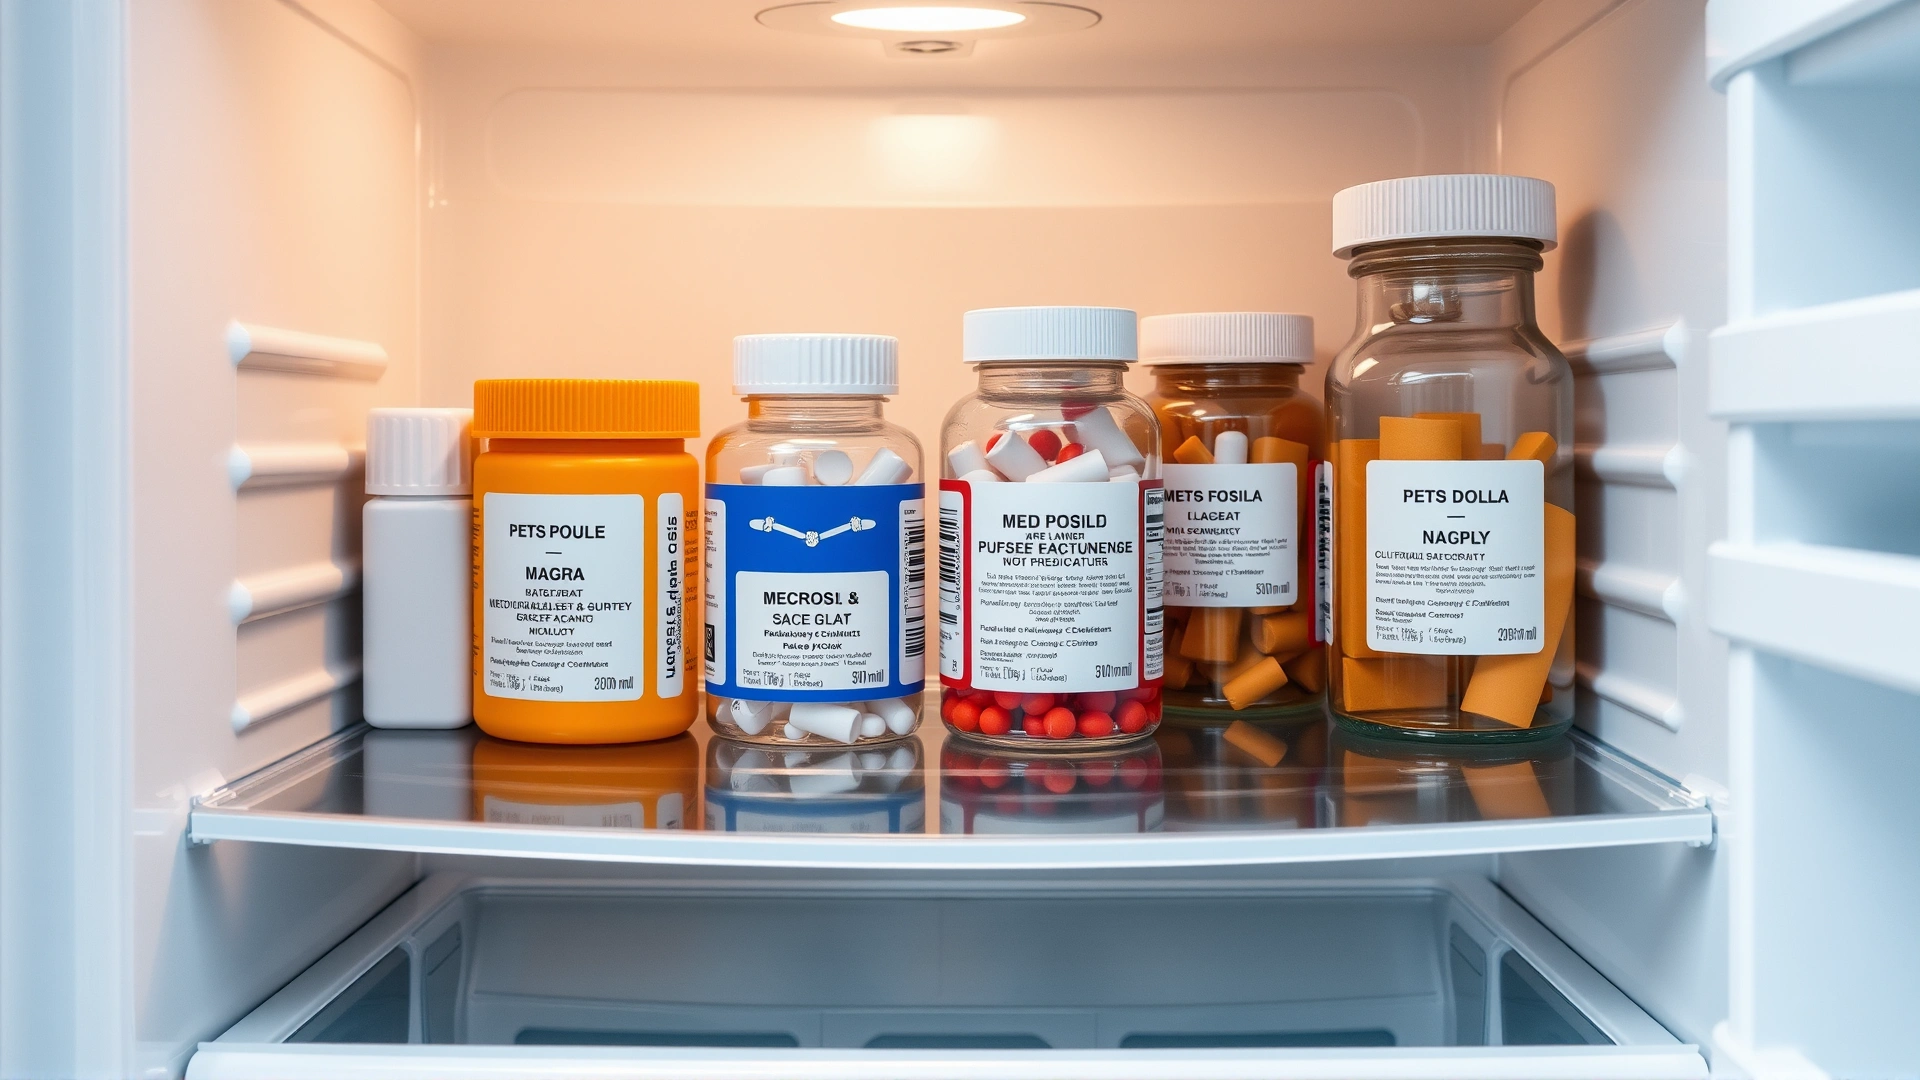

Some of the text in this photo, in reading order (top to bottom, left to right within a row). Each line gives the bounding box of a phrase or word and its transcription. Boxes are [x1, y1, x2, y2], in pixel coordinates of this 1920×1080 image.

[1208, 490, 1262, 502] FOSILA
[1403, 489, 1509, 504] PETS DOLLA
[1003, 514, 1106, 528] MED POSILD
[510, 524, 606, 539] PETS POULE
[1422, 530, 1490, 544] NAGPLY
[1003, 557, 1027, 566] NOT
[526, 566, 585, 580] MAGRA
[848, 591, 859, 606] &
[772, 612, 852, 626] SACE GLAT
